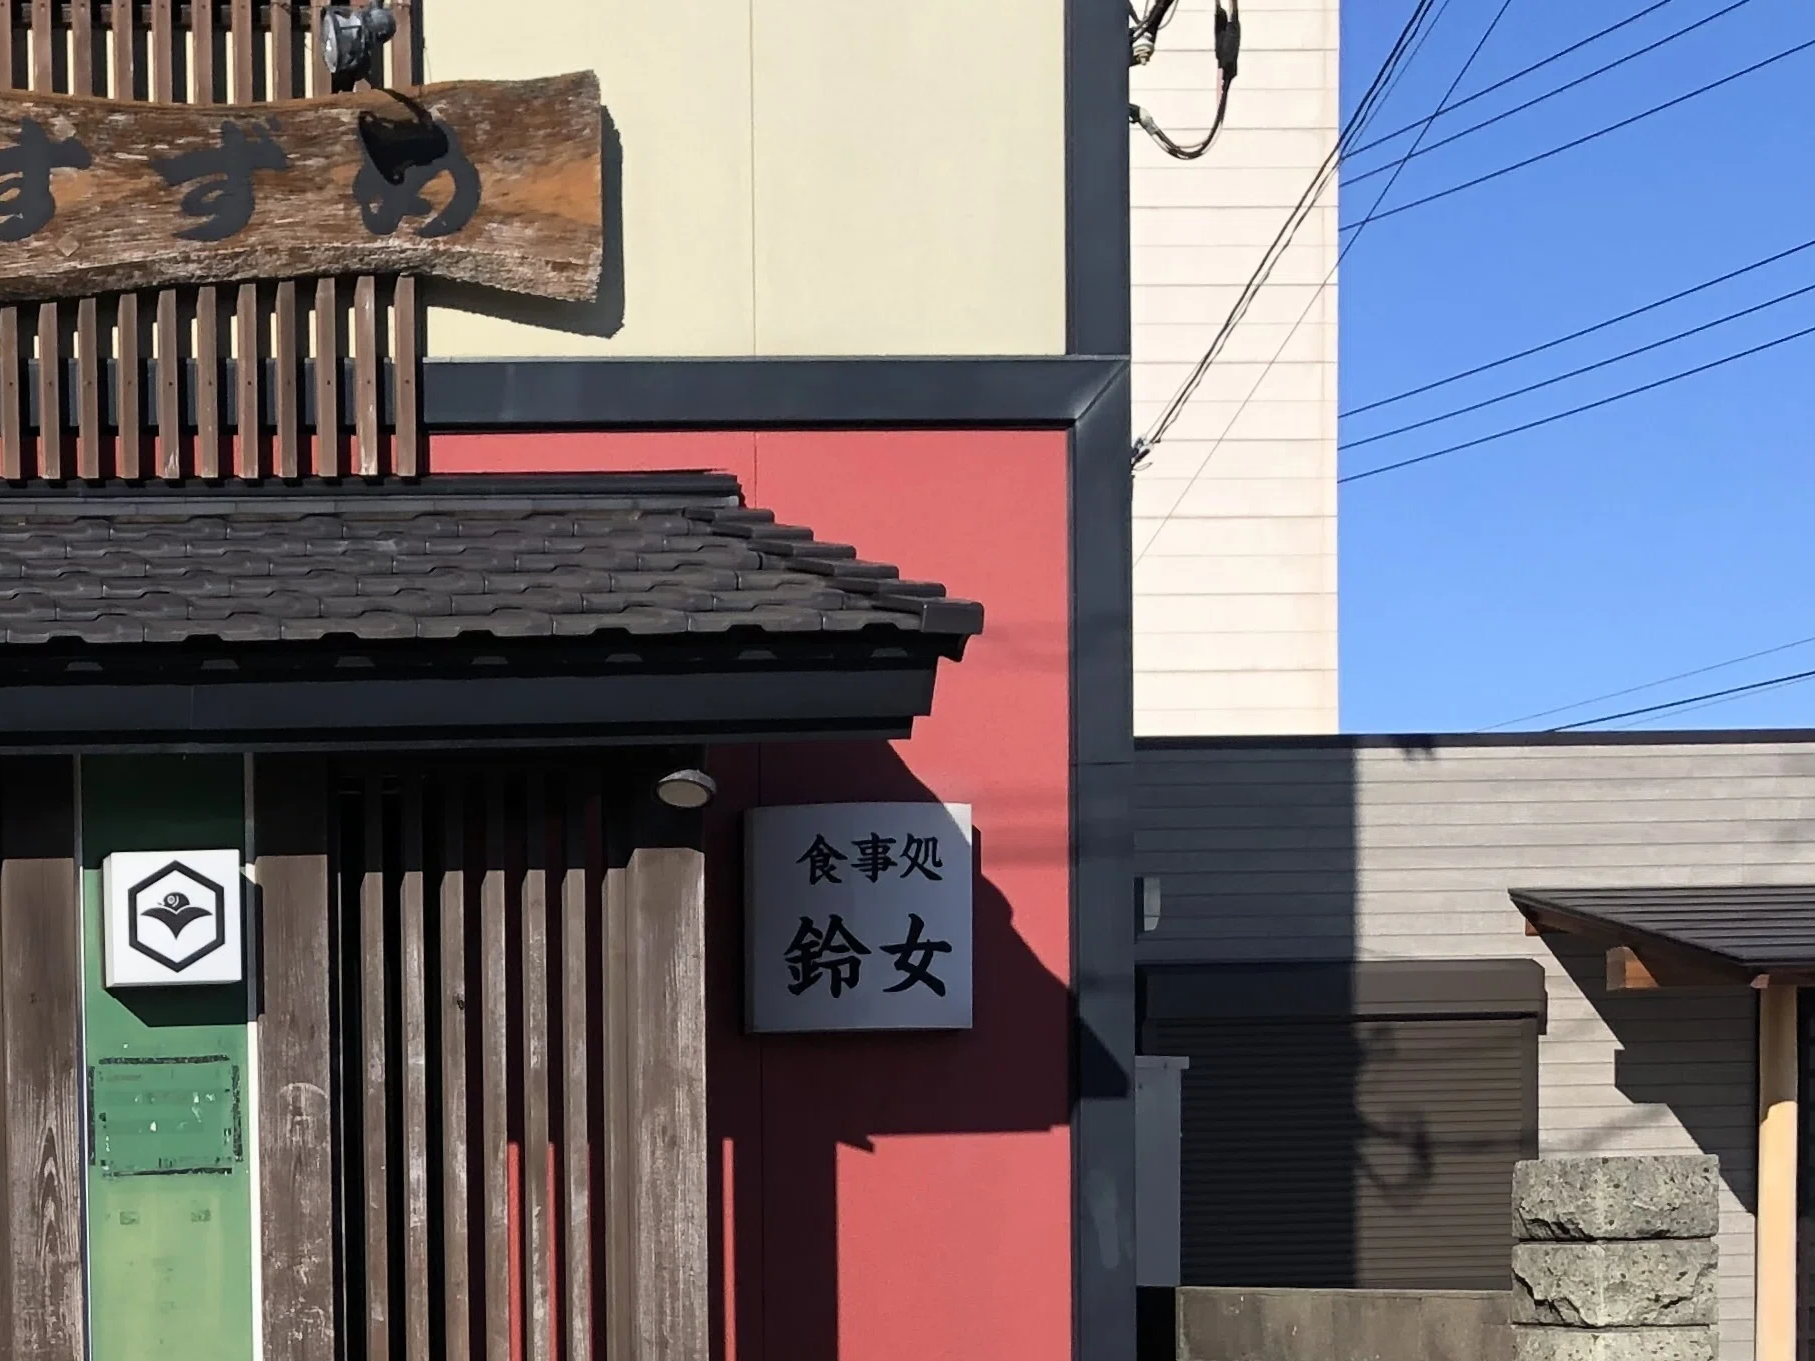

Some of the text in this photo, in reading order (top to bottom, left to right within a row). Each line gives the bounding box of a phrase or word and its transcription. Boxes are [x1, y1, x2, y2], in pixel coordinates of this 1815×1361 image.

[796, 832, 943, 885] 食事処
[783, 913, 953, 999] 鈴女
